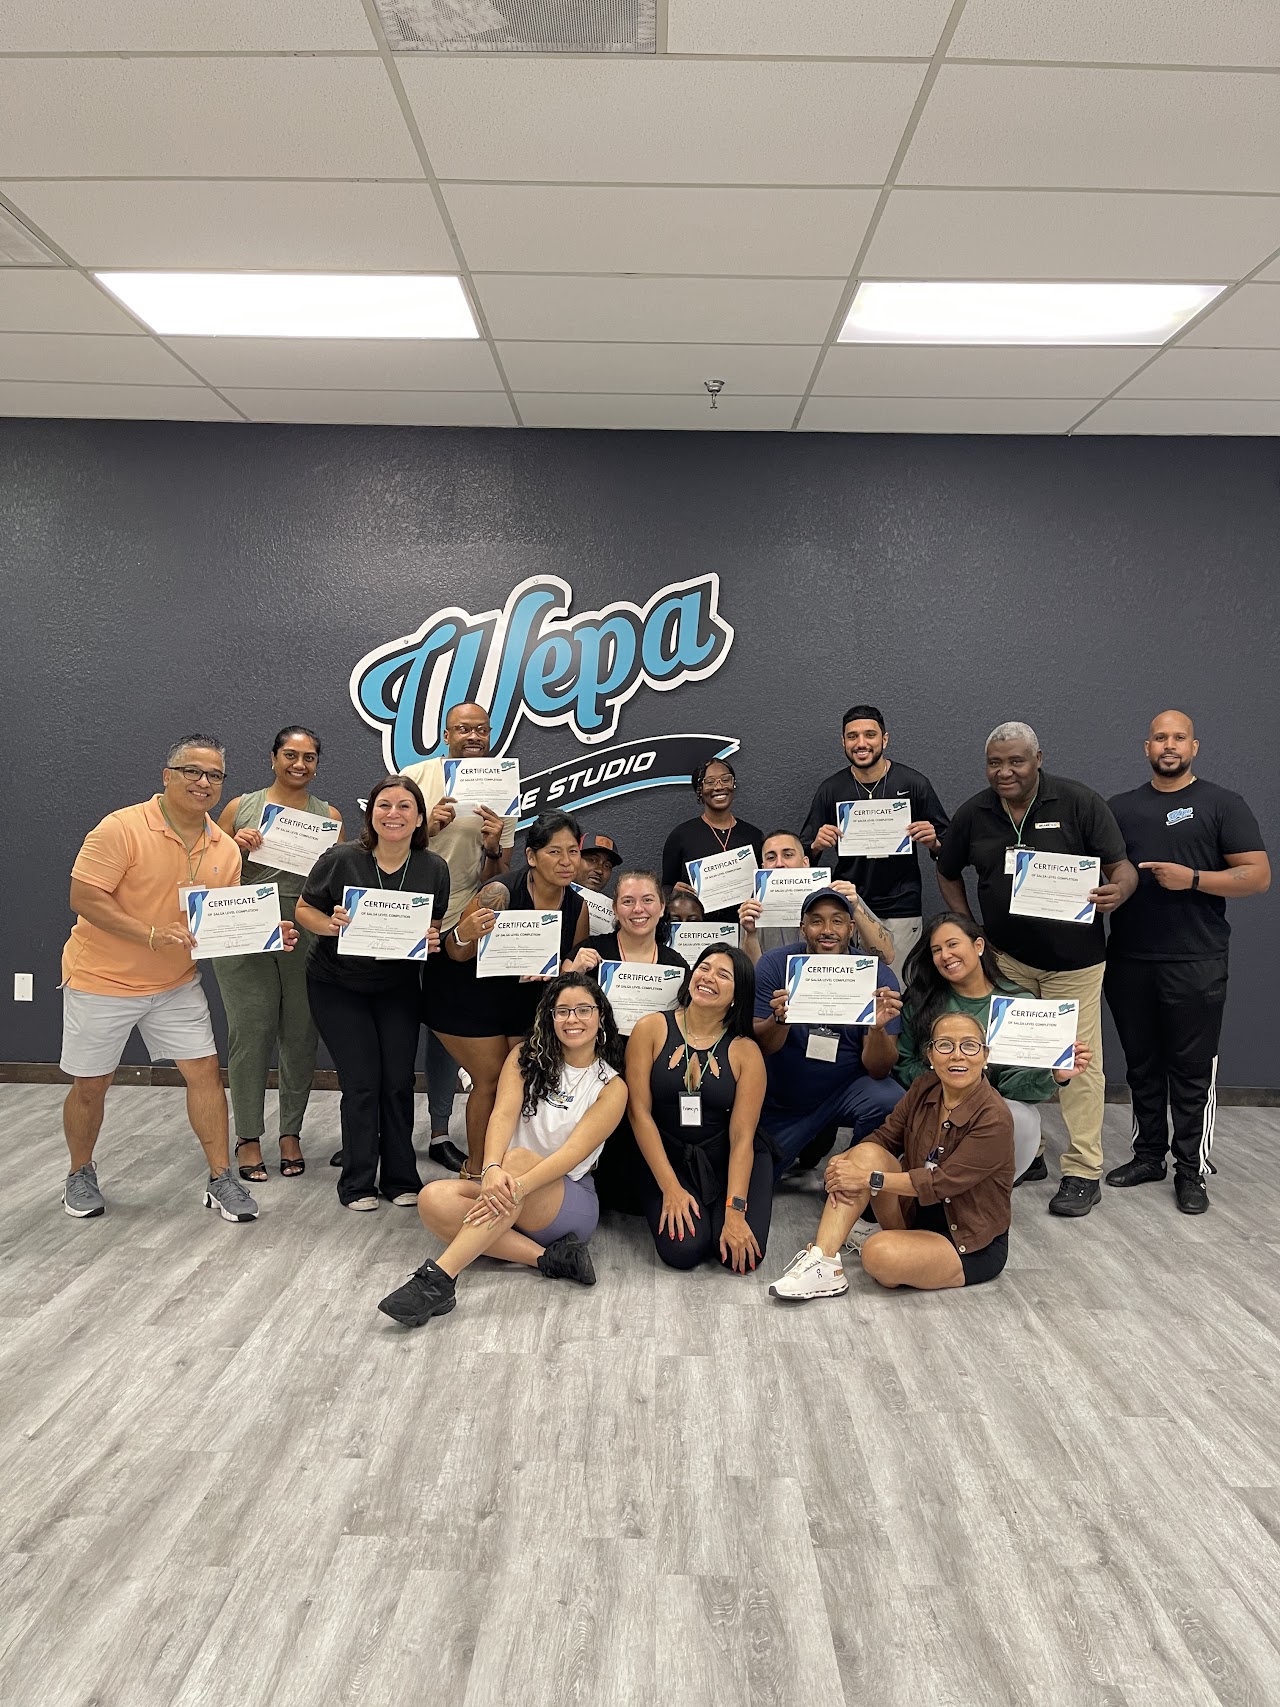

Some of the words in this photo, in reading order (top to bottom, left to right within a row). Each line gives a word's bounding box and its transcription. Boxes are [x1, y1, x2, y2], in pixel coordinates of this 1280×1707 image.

[354, 580, 725, 774] Wepa
[546, 751, 656, 802] STUDIO
[280, 817, 319, 832] CERTIFICATE
[704, 859, 738, 872] CERTIFICATE
[1034, 863, 1077, 873] CERTIFICATE
[209, 897, 255, 907] CERTIFICATE
[364, 901, 410, 910] CERTIFICATE
[618, 974, 662, 982] CERTIFICATE
[1011, 1010, 1056, 1018] CERTIFICATE
